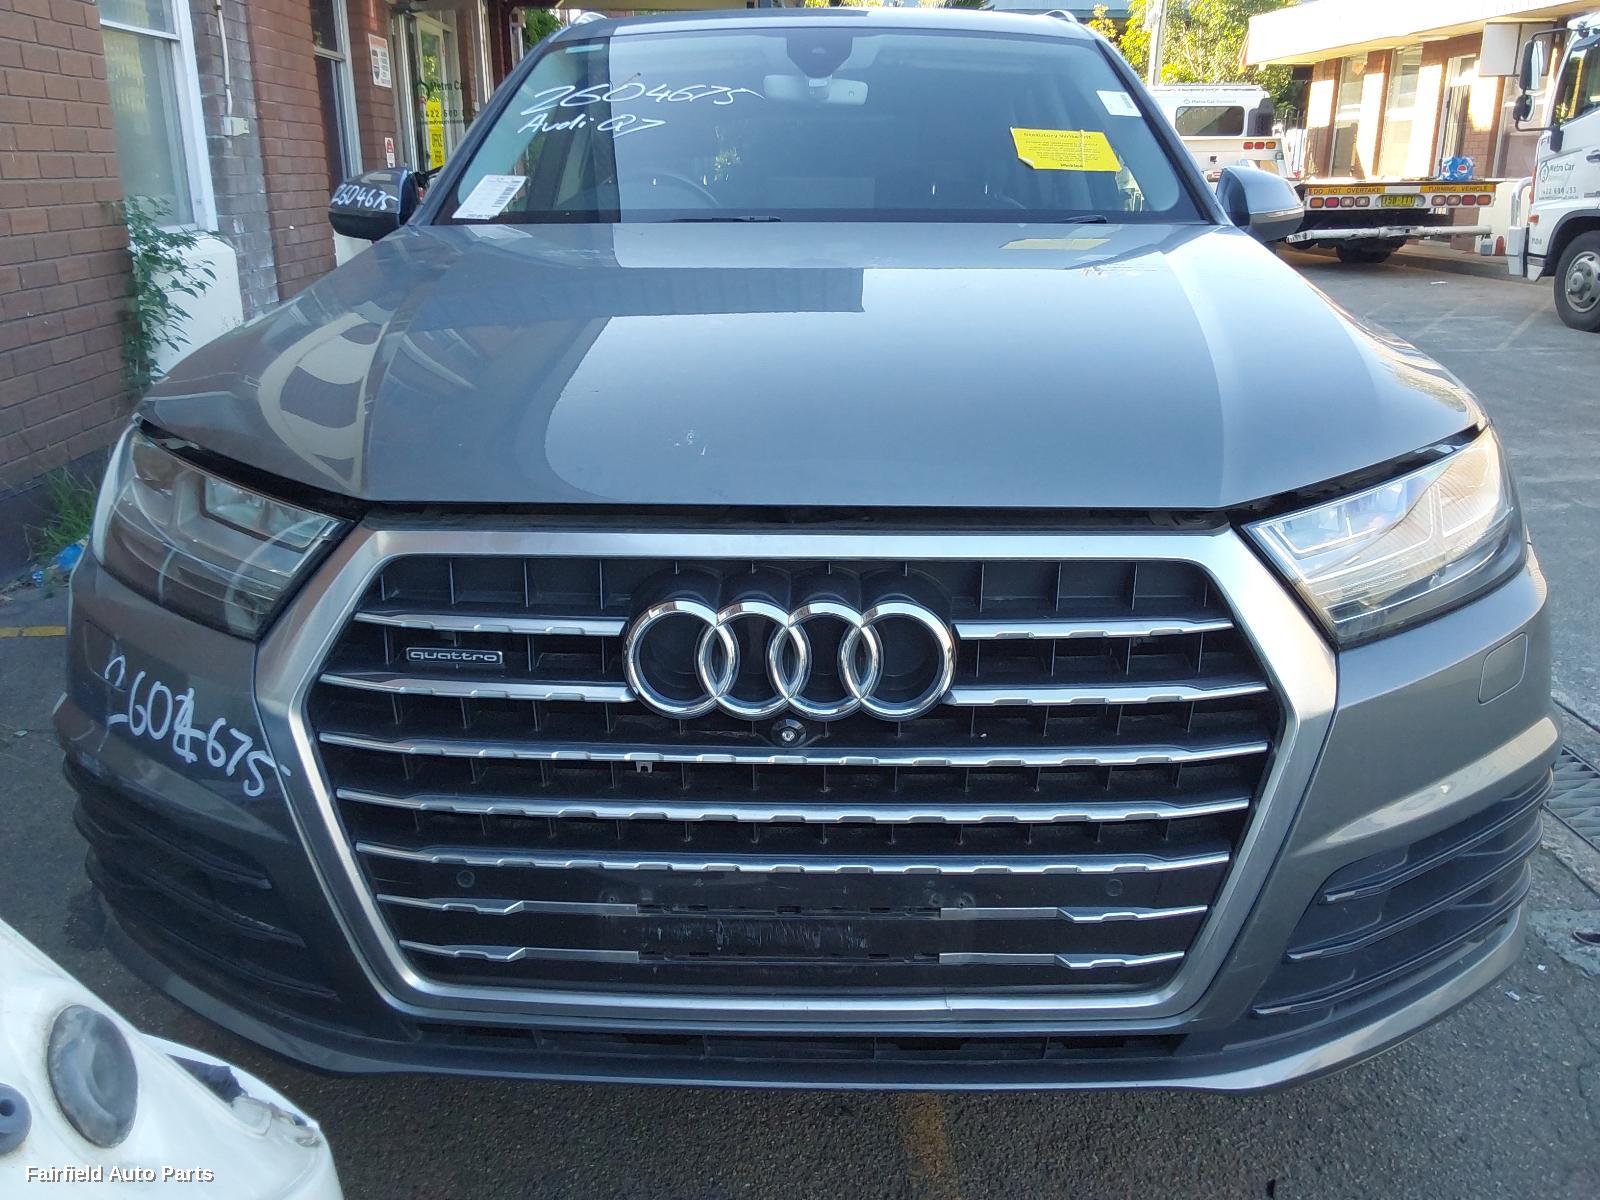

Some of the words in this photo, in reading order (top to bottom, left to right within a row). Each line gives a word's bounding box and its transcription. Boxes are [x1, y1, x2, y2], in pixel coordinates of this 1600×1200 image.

[520, 82, 765, 116] 2604675
[517, 112, 587, 135] Audi
[410, 650, 497, 662] quattro
